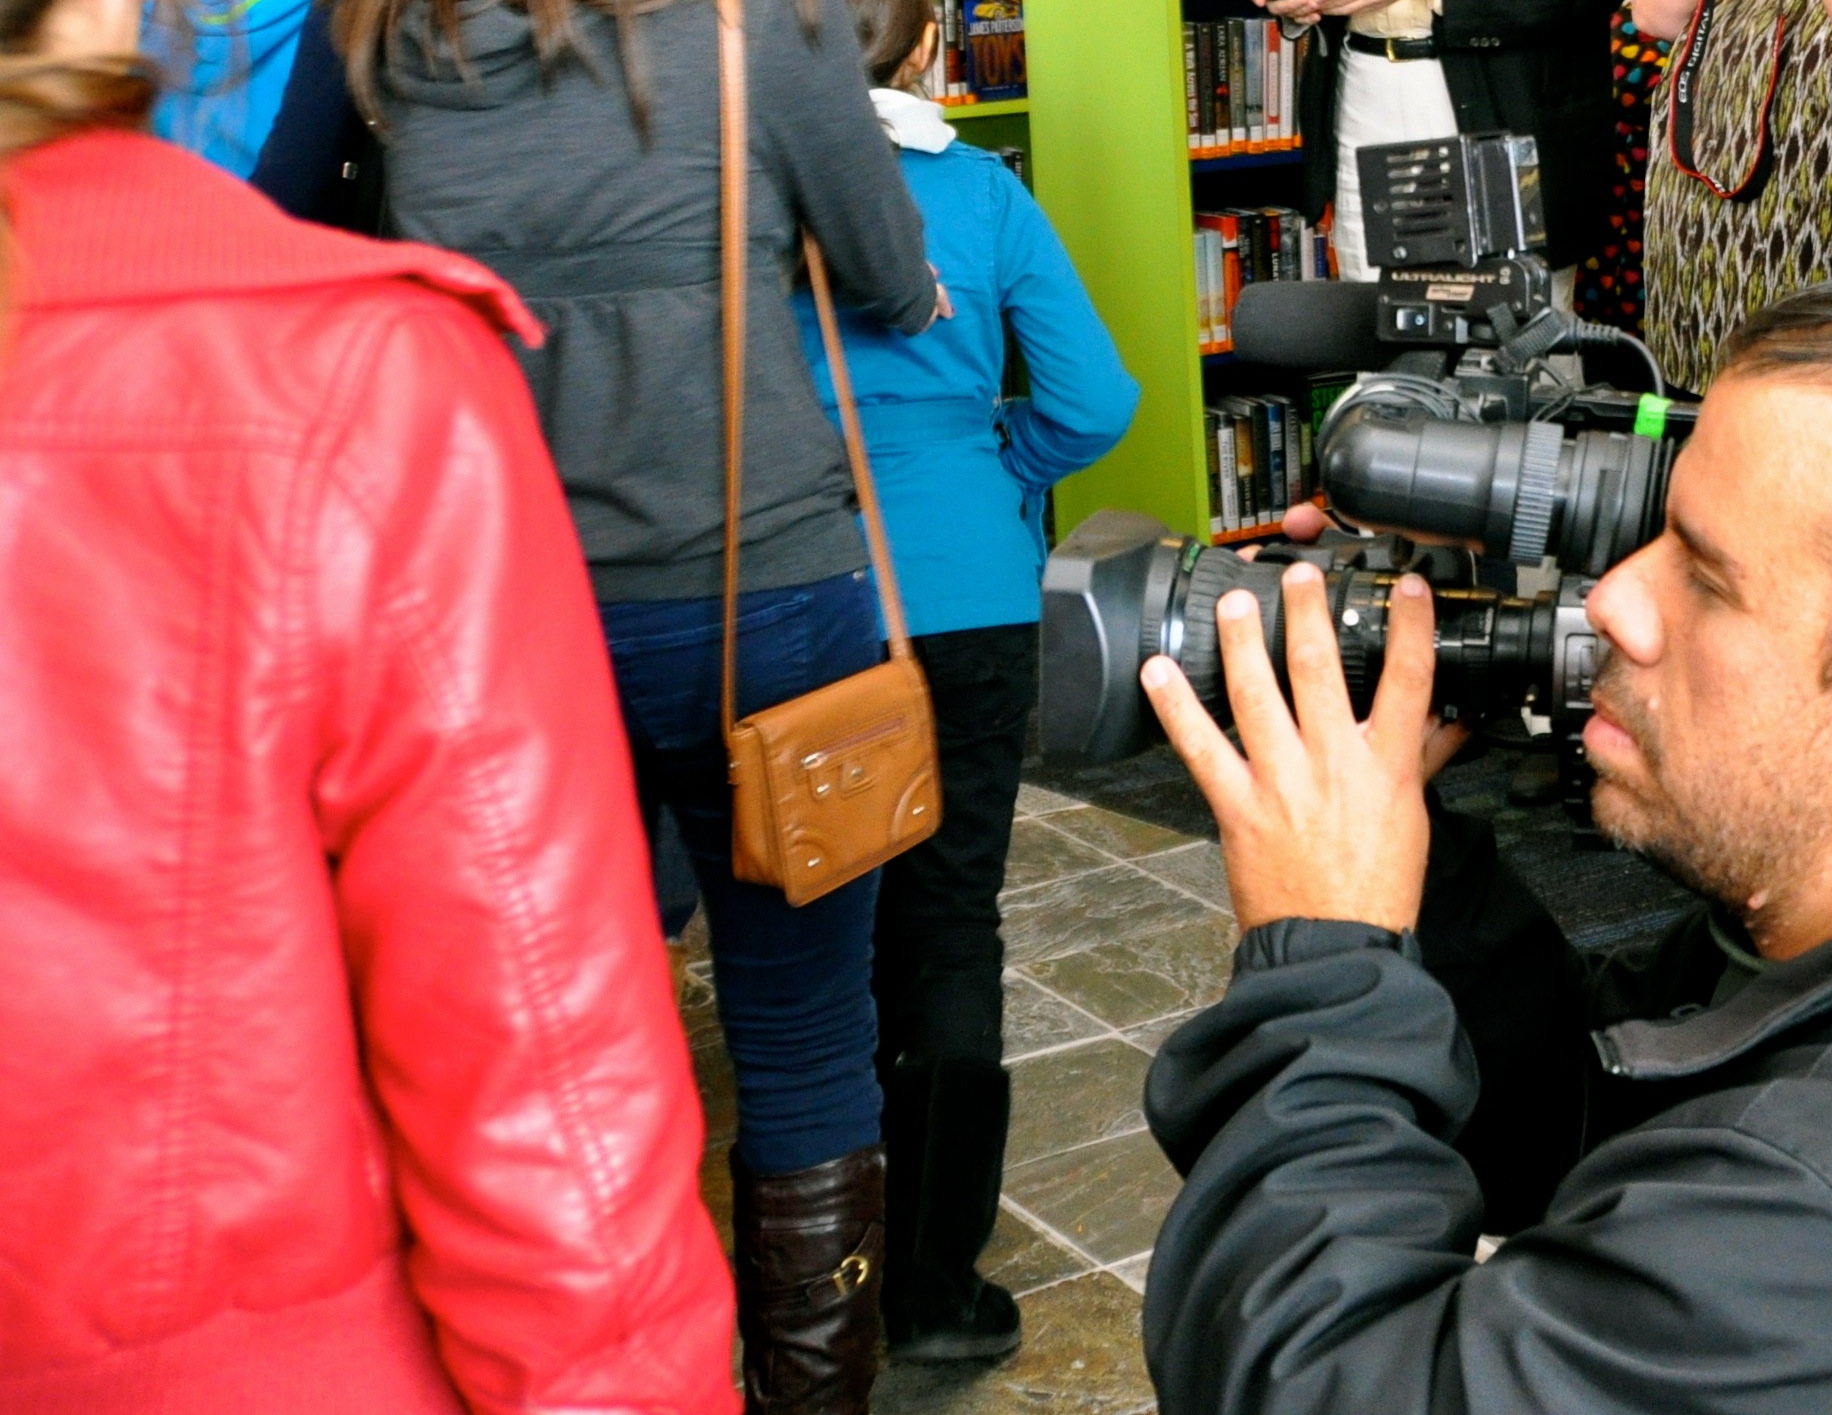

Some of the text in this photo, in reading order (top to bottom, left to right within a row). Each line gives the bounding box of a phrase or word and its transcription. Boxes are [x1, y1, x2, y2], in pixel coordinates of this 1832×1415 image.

[968, 20, 990, 36] JAMES
[1217, 24, 1227, 82] LARA ADRIAN
[1677, 8, 1710, 104] EOS DIGITAL
[1186, 71, 1196, 97] Across
[1391, 271, 1496, 283] ULTRALIGHT
